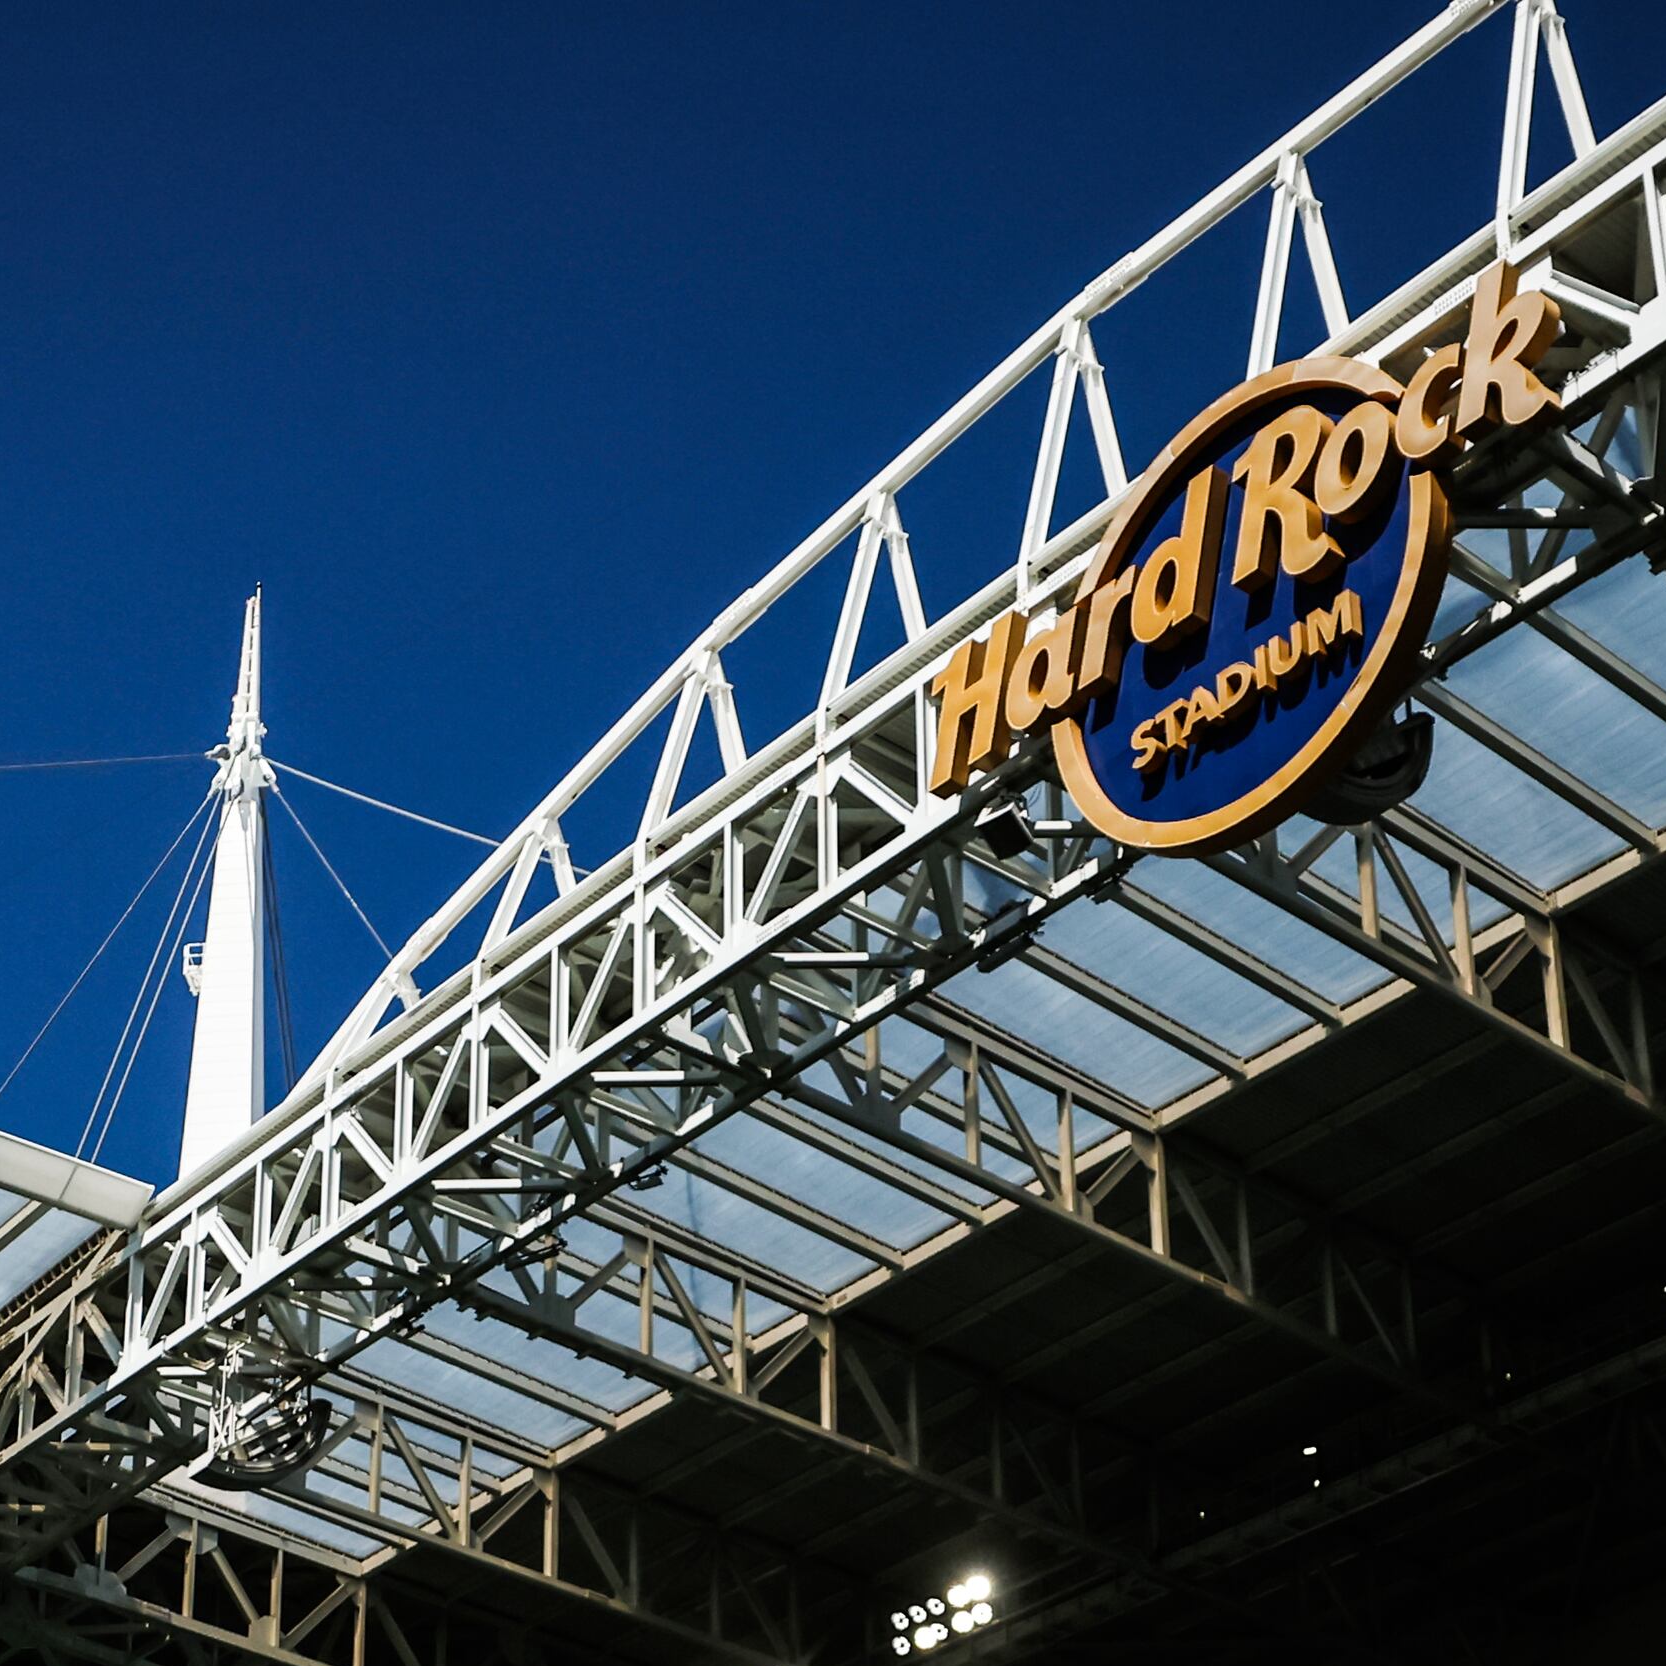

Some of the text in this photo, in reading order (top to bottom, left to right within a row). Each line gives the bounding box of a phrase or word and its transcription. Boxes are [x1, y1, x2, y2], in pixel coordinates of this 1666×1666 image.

[929, 261, 1563, 797] Hard Rock
[1130, 589, 1362, 774] STADIUM
